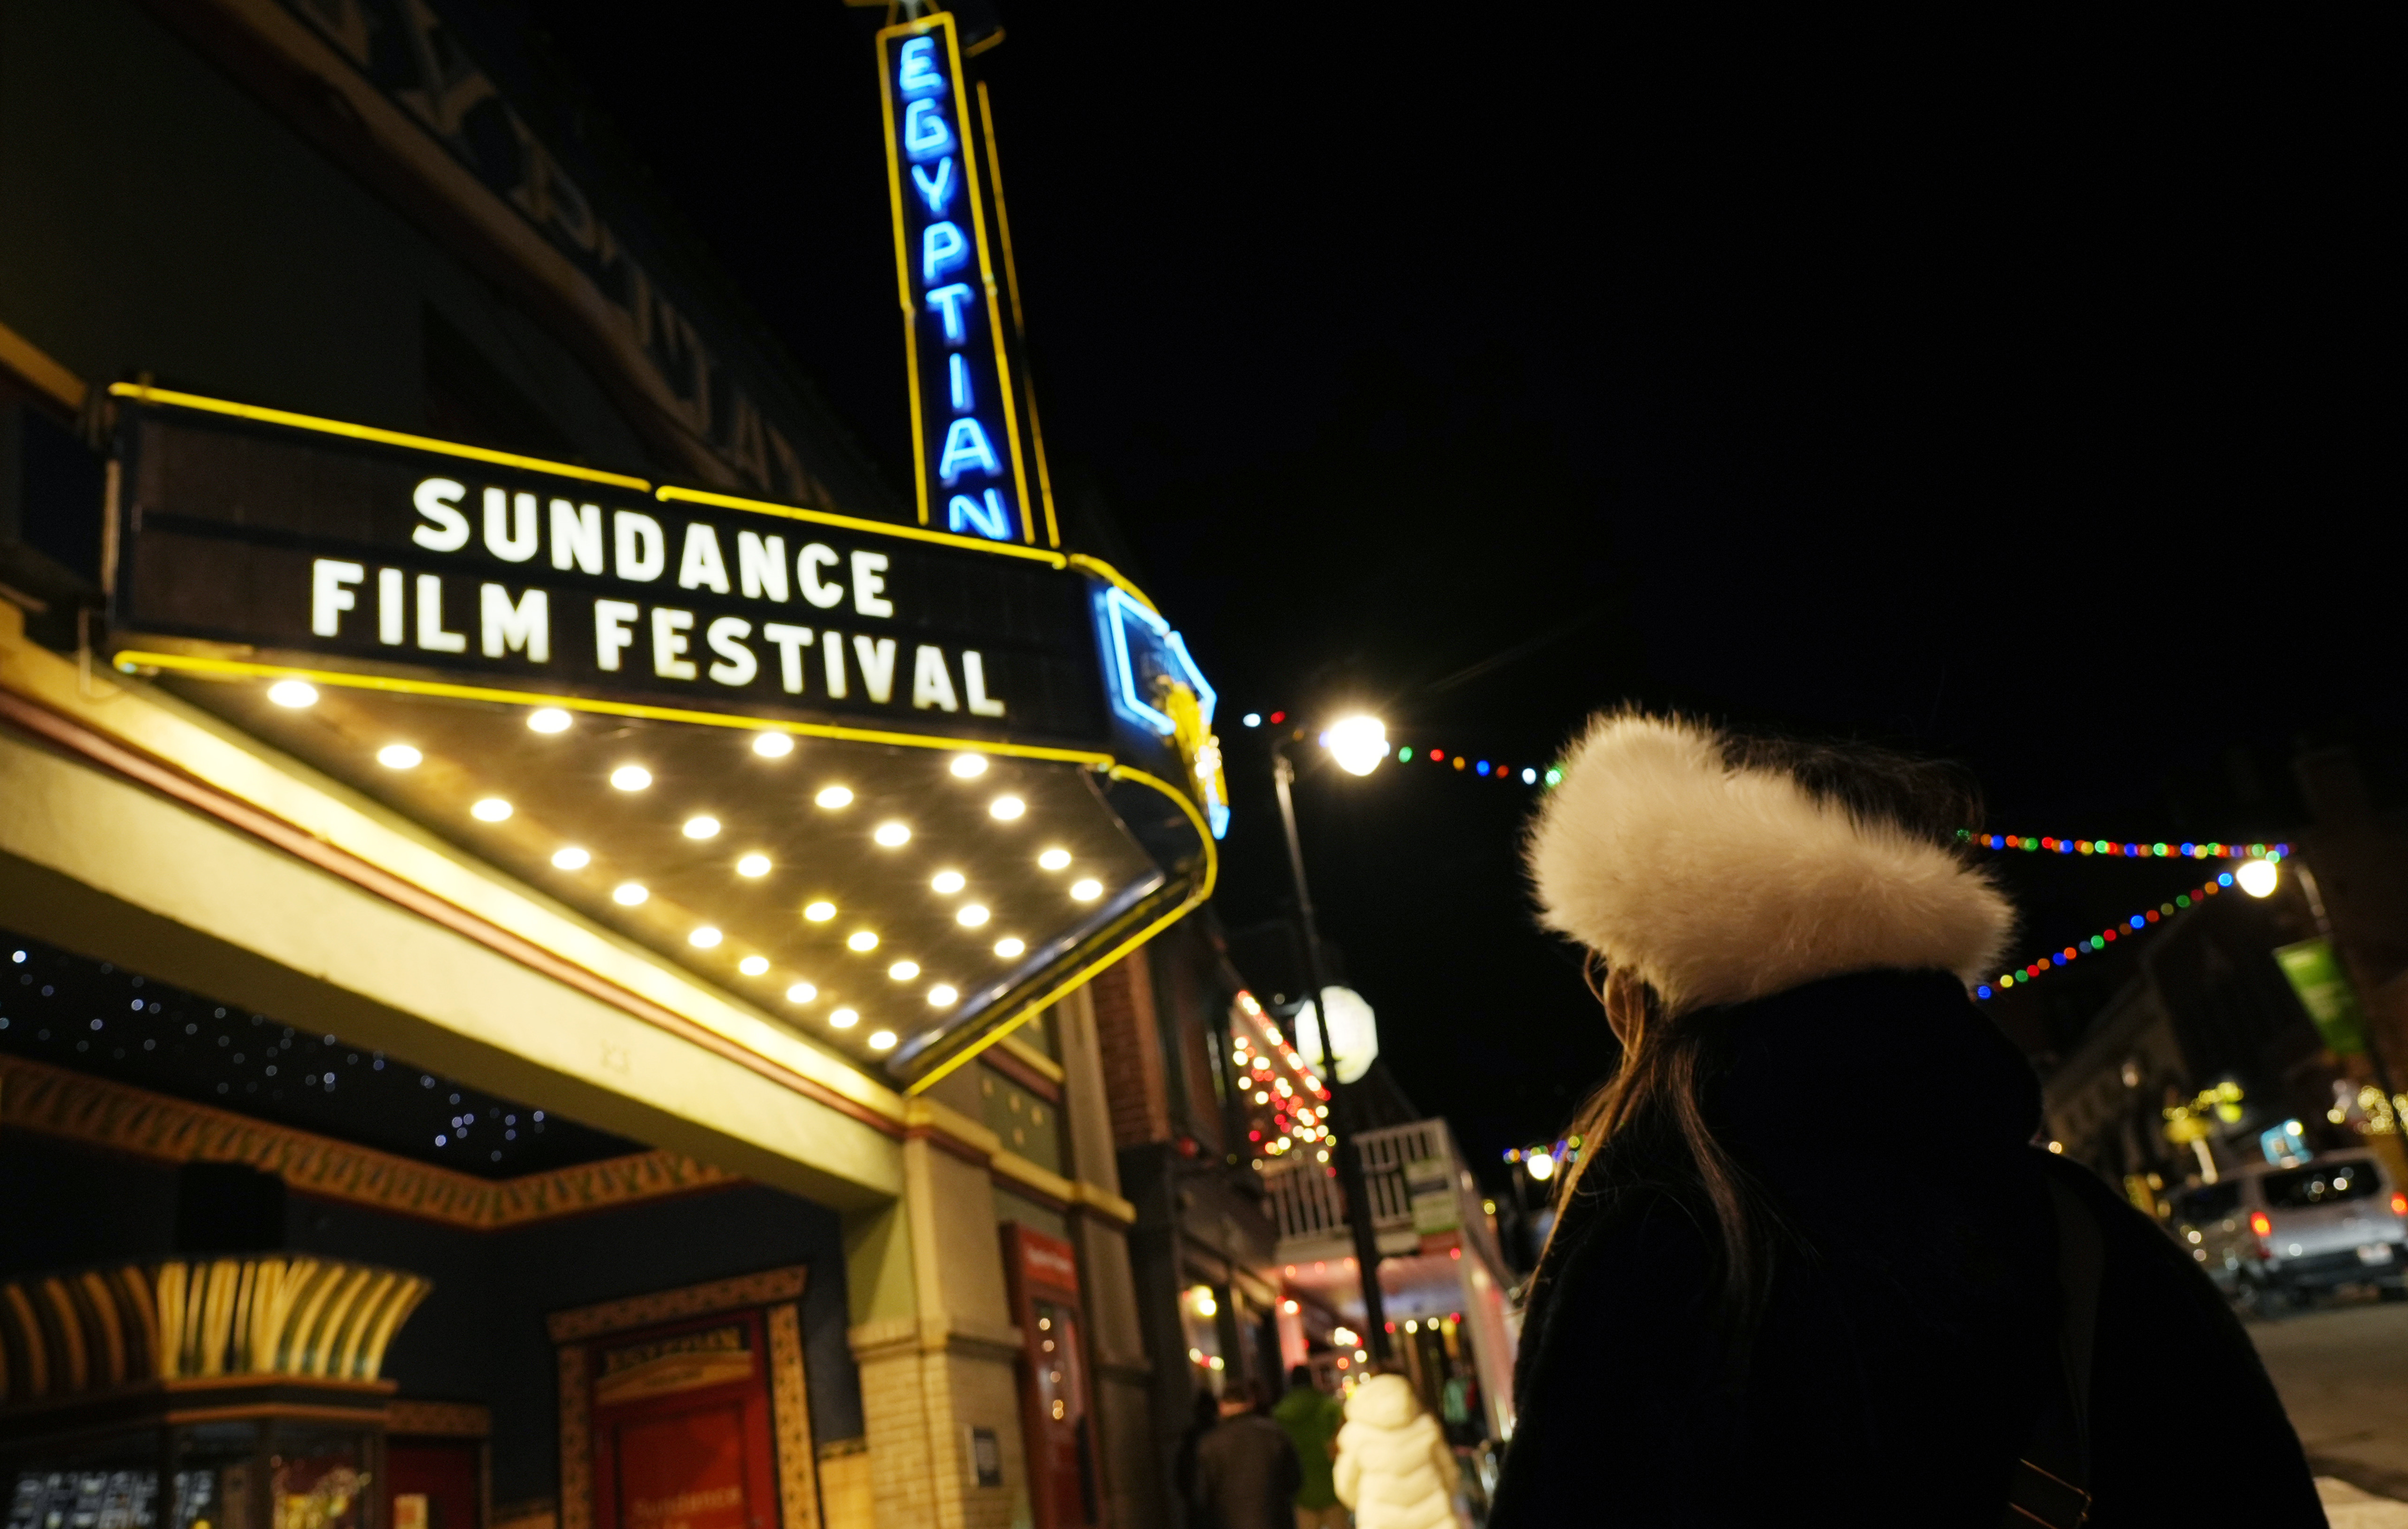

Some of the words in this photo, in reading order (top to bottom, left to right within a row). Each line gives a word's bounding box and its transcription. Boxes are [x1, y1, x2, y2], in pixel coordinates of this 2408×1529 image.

[899, 36, 1010, 539] EGYPTIAN
[412, 477, 894, 619] SUNDANCE
[311, 558, 549, 662] FILM
[594, 599, 1003, 716] FESTIVAL
